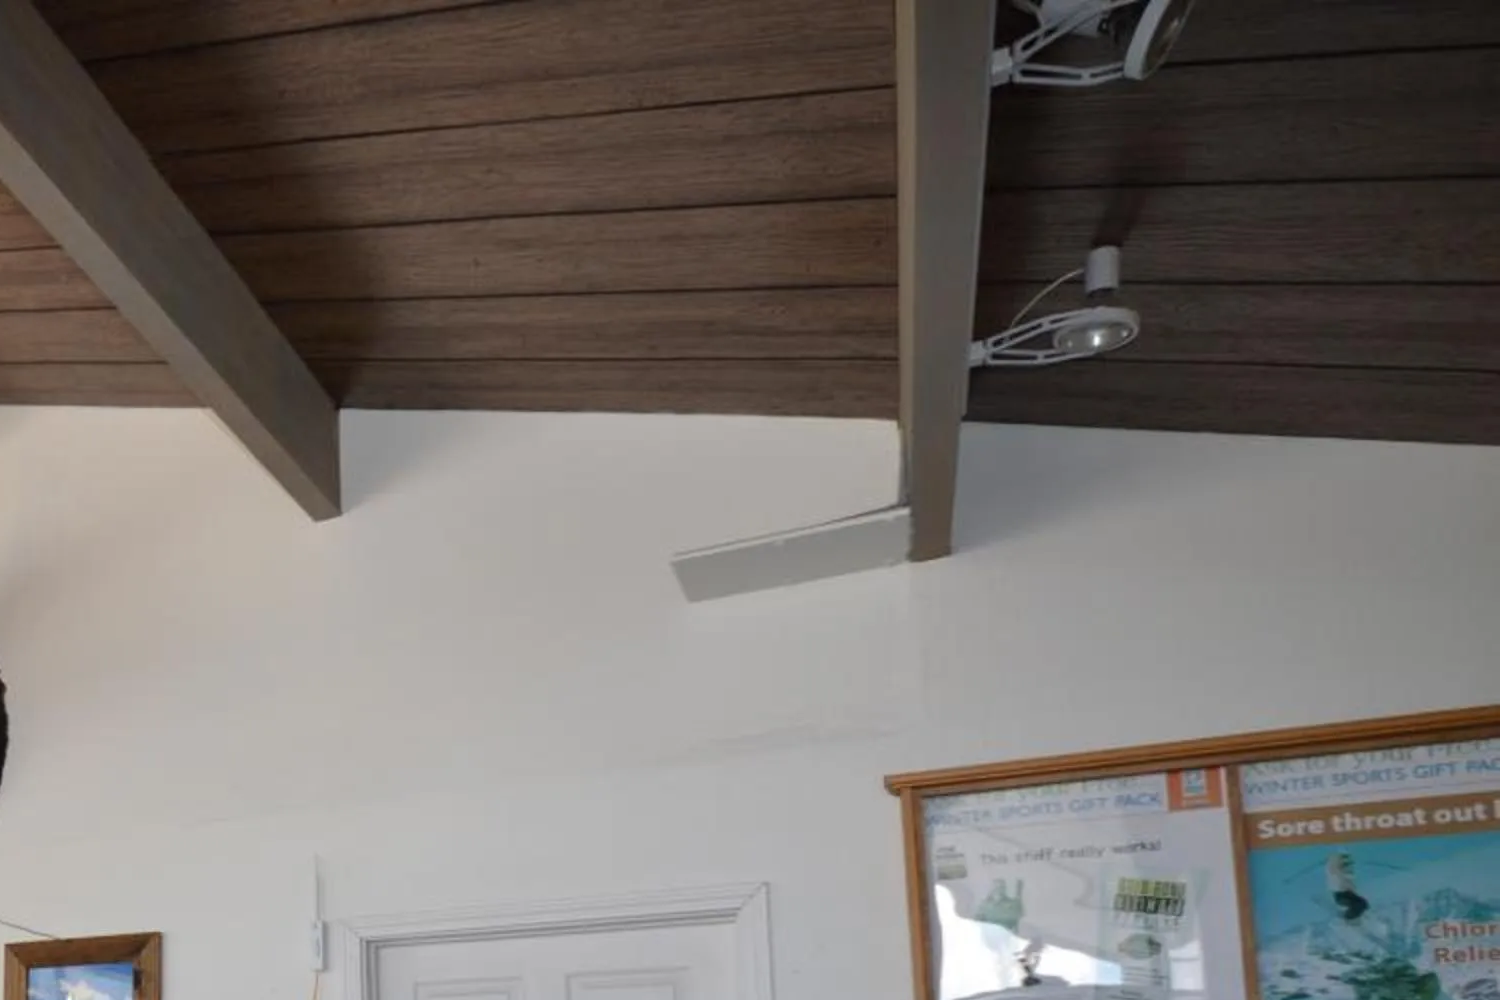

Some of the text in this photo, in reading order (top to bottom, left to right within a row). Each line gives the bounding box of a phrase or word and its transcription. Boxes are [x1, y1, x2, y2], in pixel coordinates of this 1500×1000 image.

[1247, 775, 1325, 795] WINTER
[1331, 768, 1409, 787] SPORTS
[1413, 761, 1457, 779] GIFT
[1257, 818, 1326, 840] Sore
[1331, 808, 1429, 833] throat
[1433, 800, 1489, 825] out
